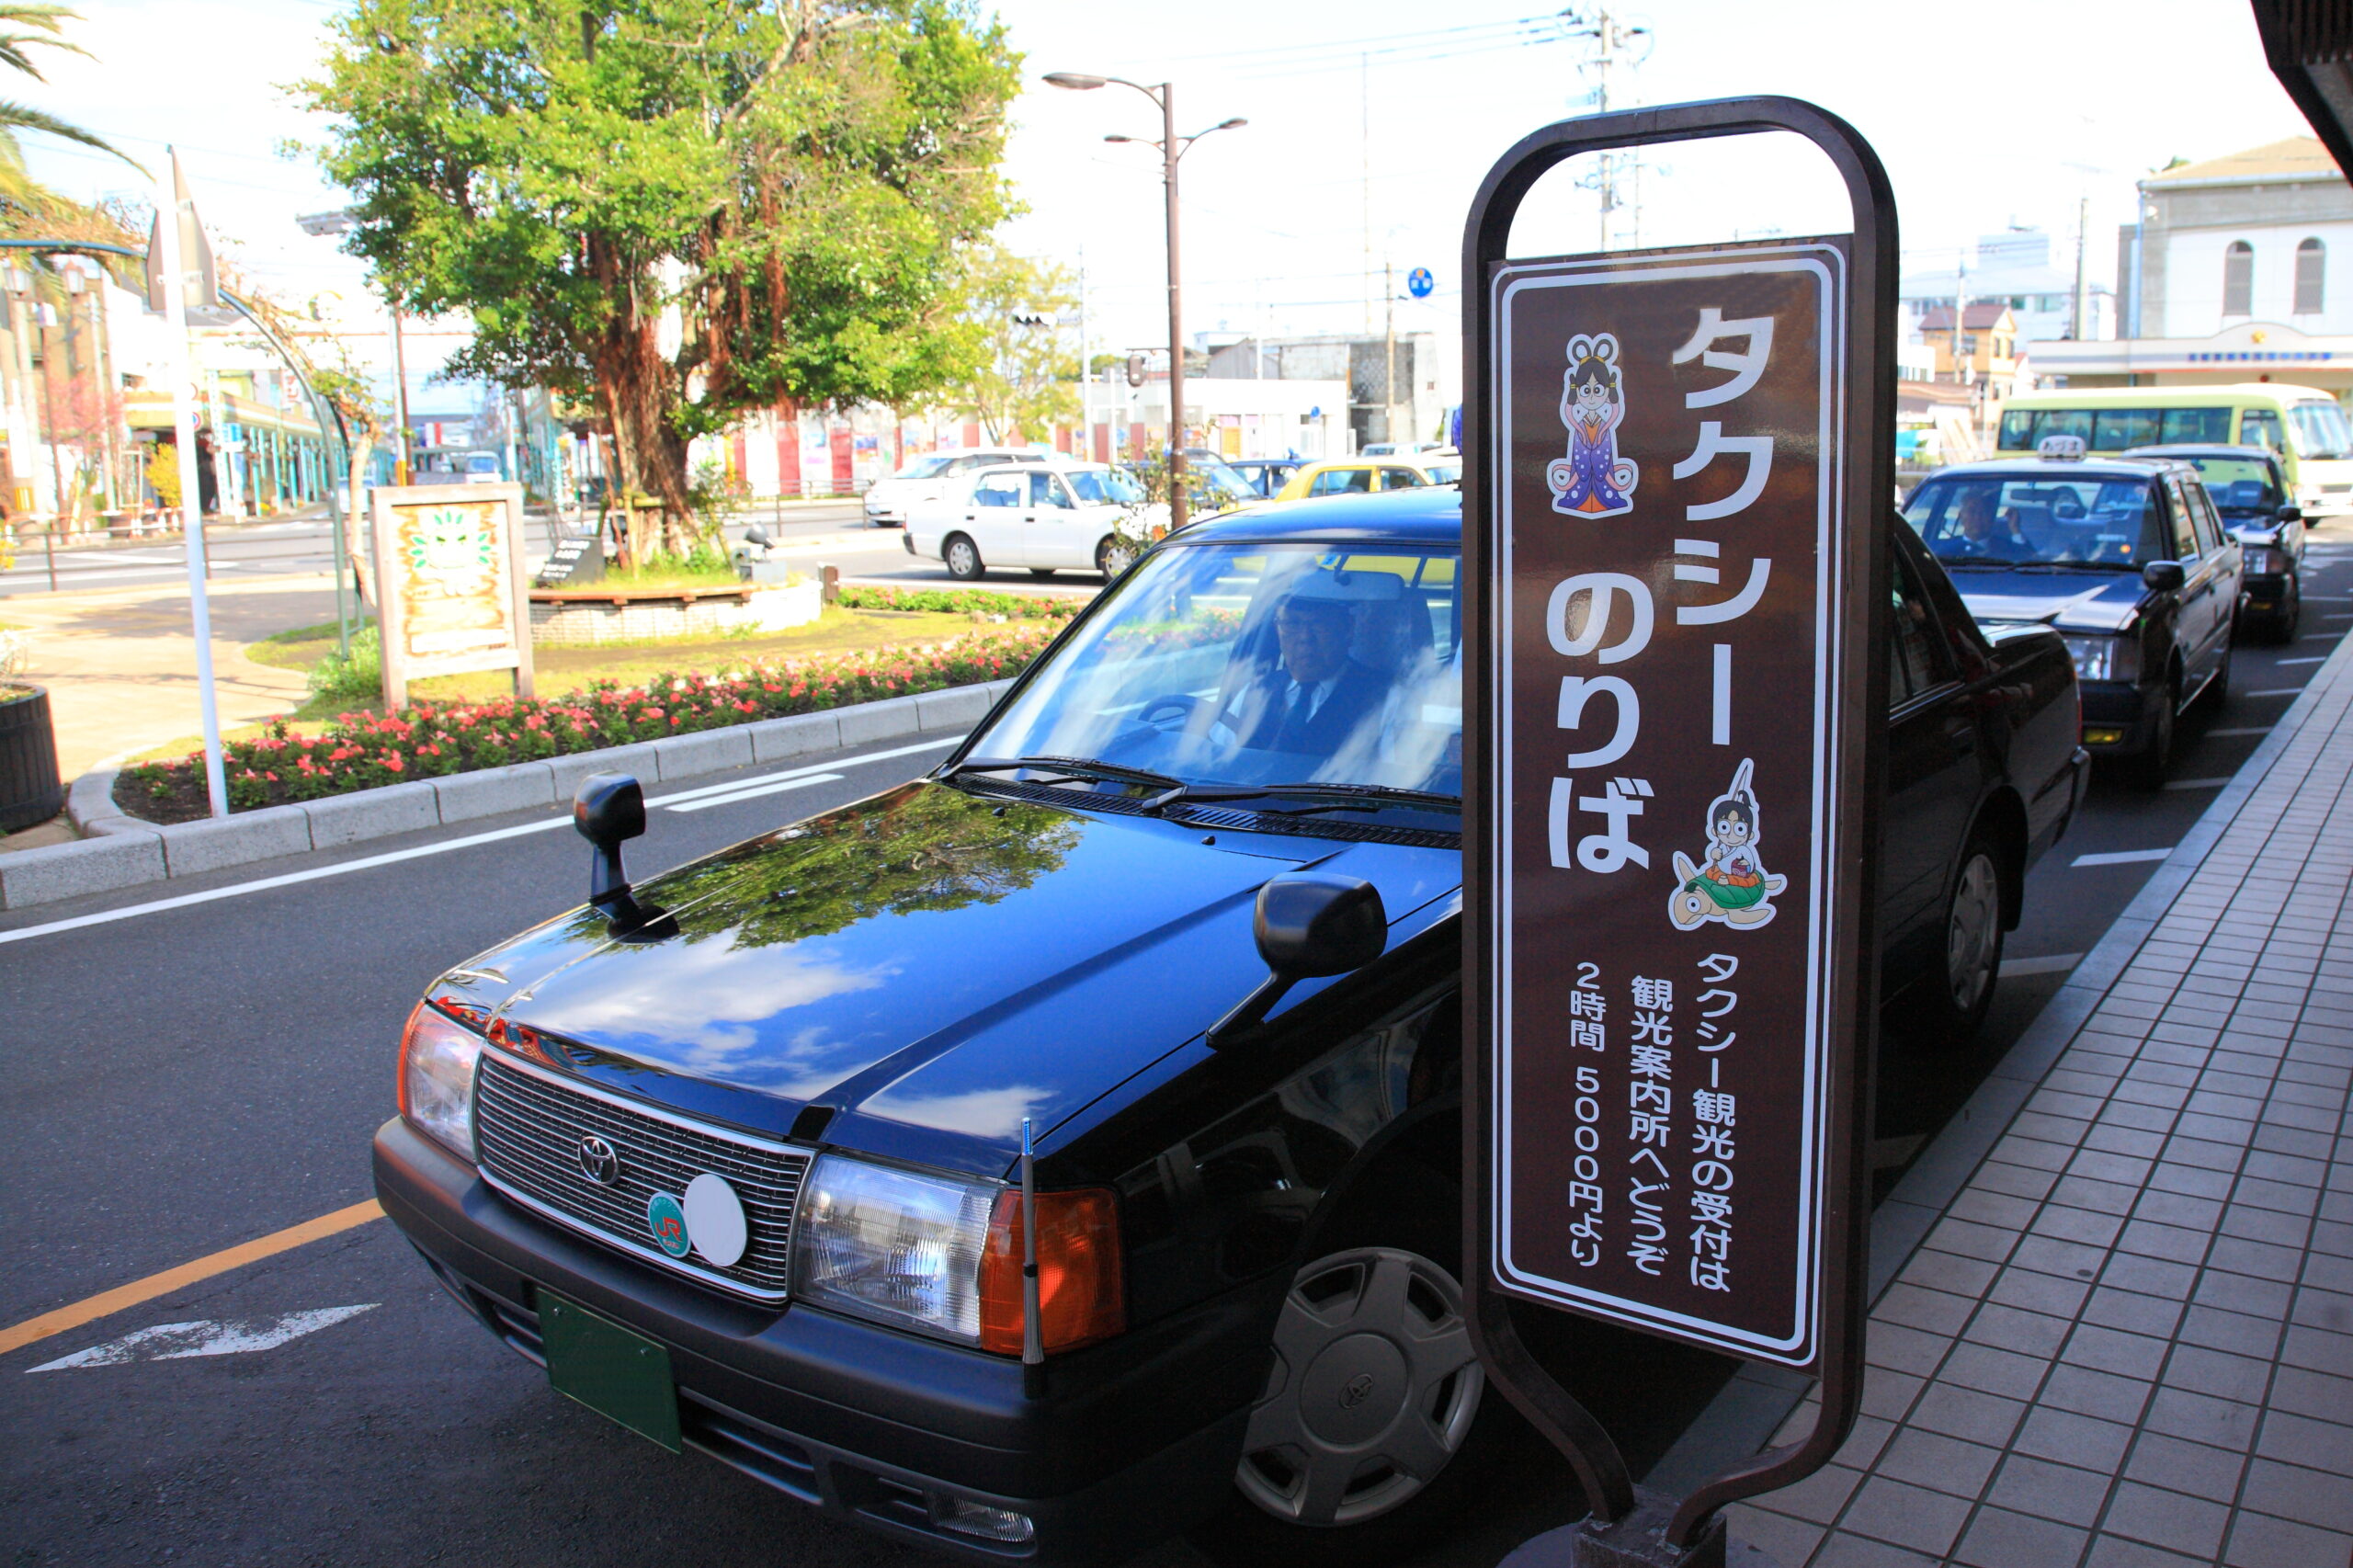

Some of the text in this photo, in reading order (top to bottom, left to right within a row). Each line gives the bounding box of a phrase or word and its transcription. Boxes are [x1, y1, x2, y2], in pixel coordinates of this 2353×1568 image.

[1672, 307, 1776, 745] タクシー
[1546, 572, 1654, 874] のりば
[654, 1216, 683, 1243] JR
[1626, 974, 1674, 1276] 観光案内所へどうぞ
[1689, 953, 1739, 1292] タクシー観光の受付は
